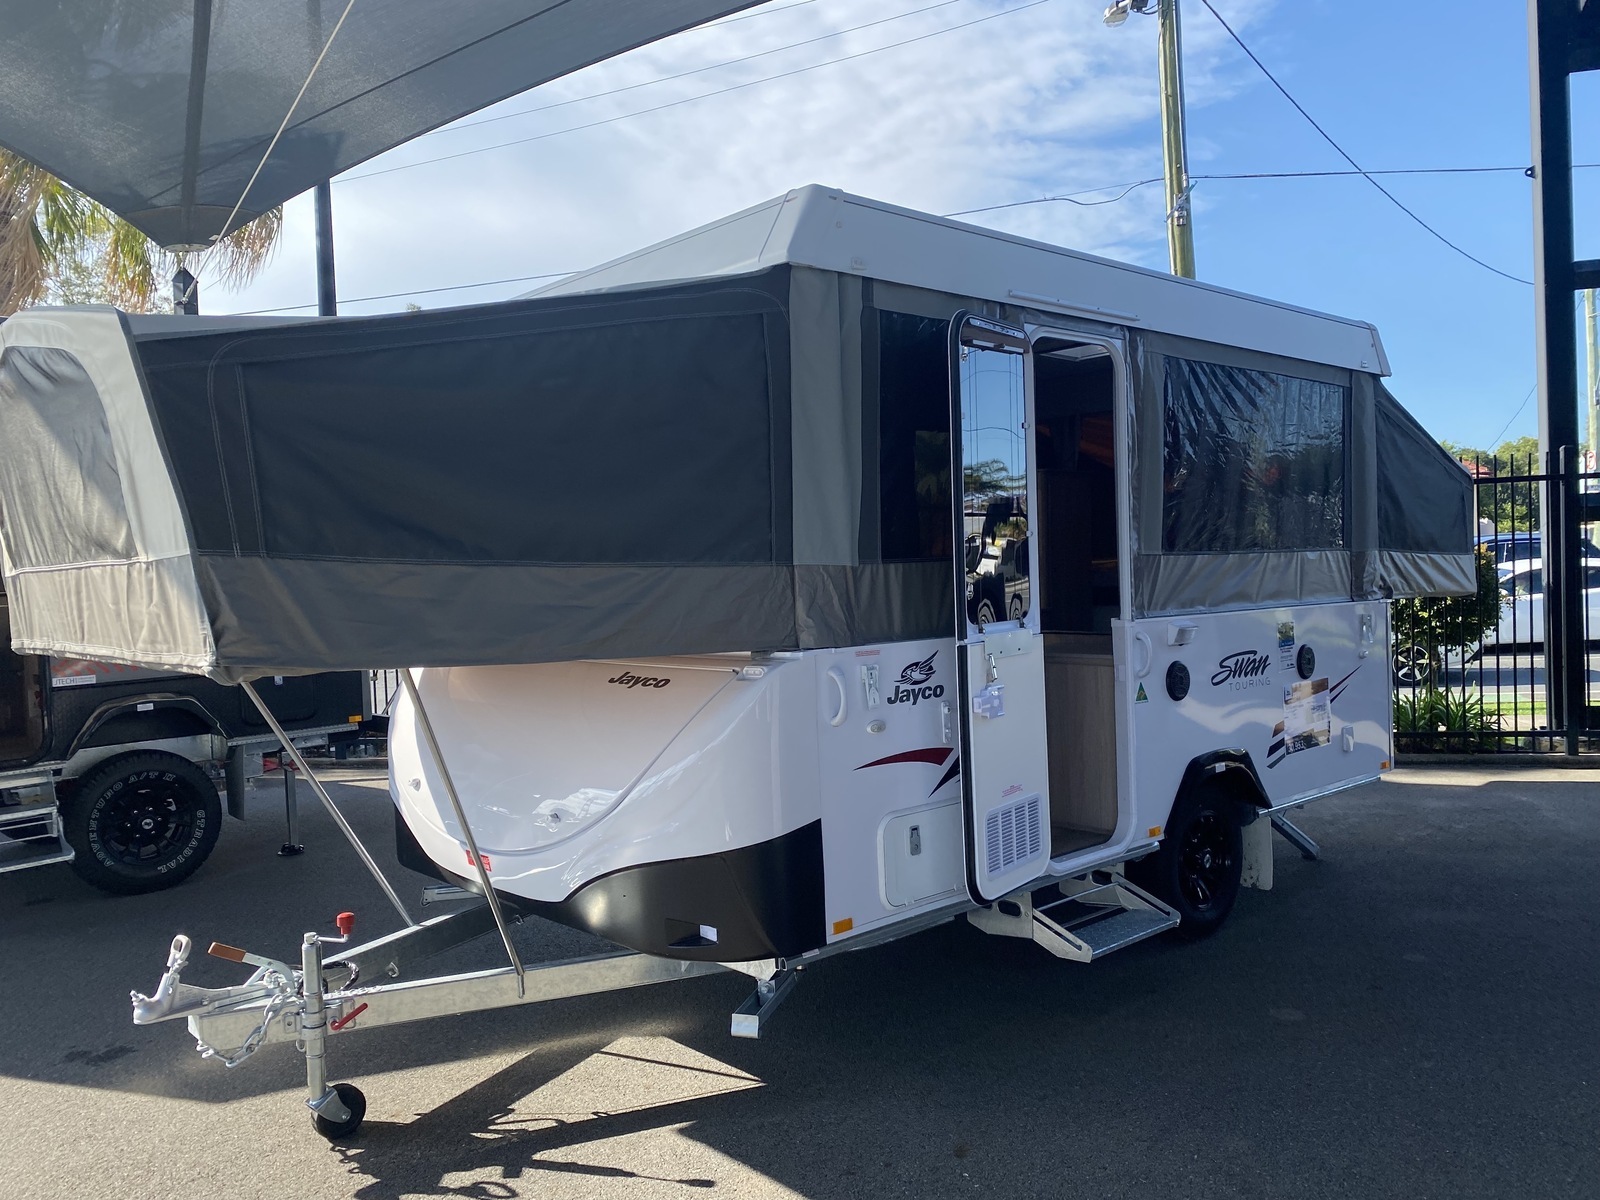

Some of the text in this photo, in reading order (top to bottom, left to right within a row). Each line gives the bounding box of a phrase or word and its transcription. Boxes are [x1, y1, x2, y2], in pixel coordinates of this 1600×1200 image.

[1211, 650, 1271, 686] Swan
[608, 671, 671, 688] Jayco
[1229, 677, 1270, 690] TOURING
[887, 685, 945, 705] Jayco
